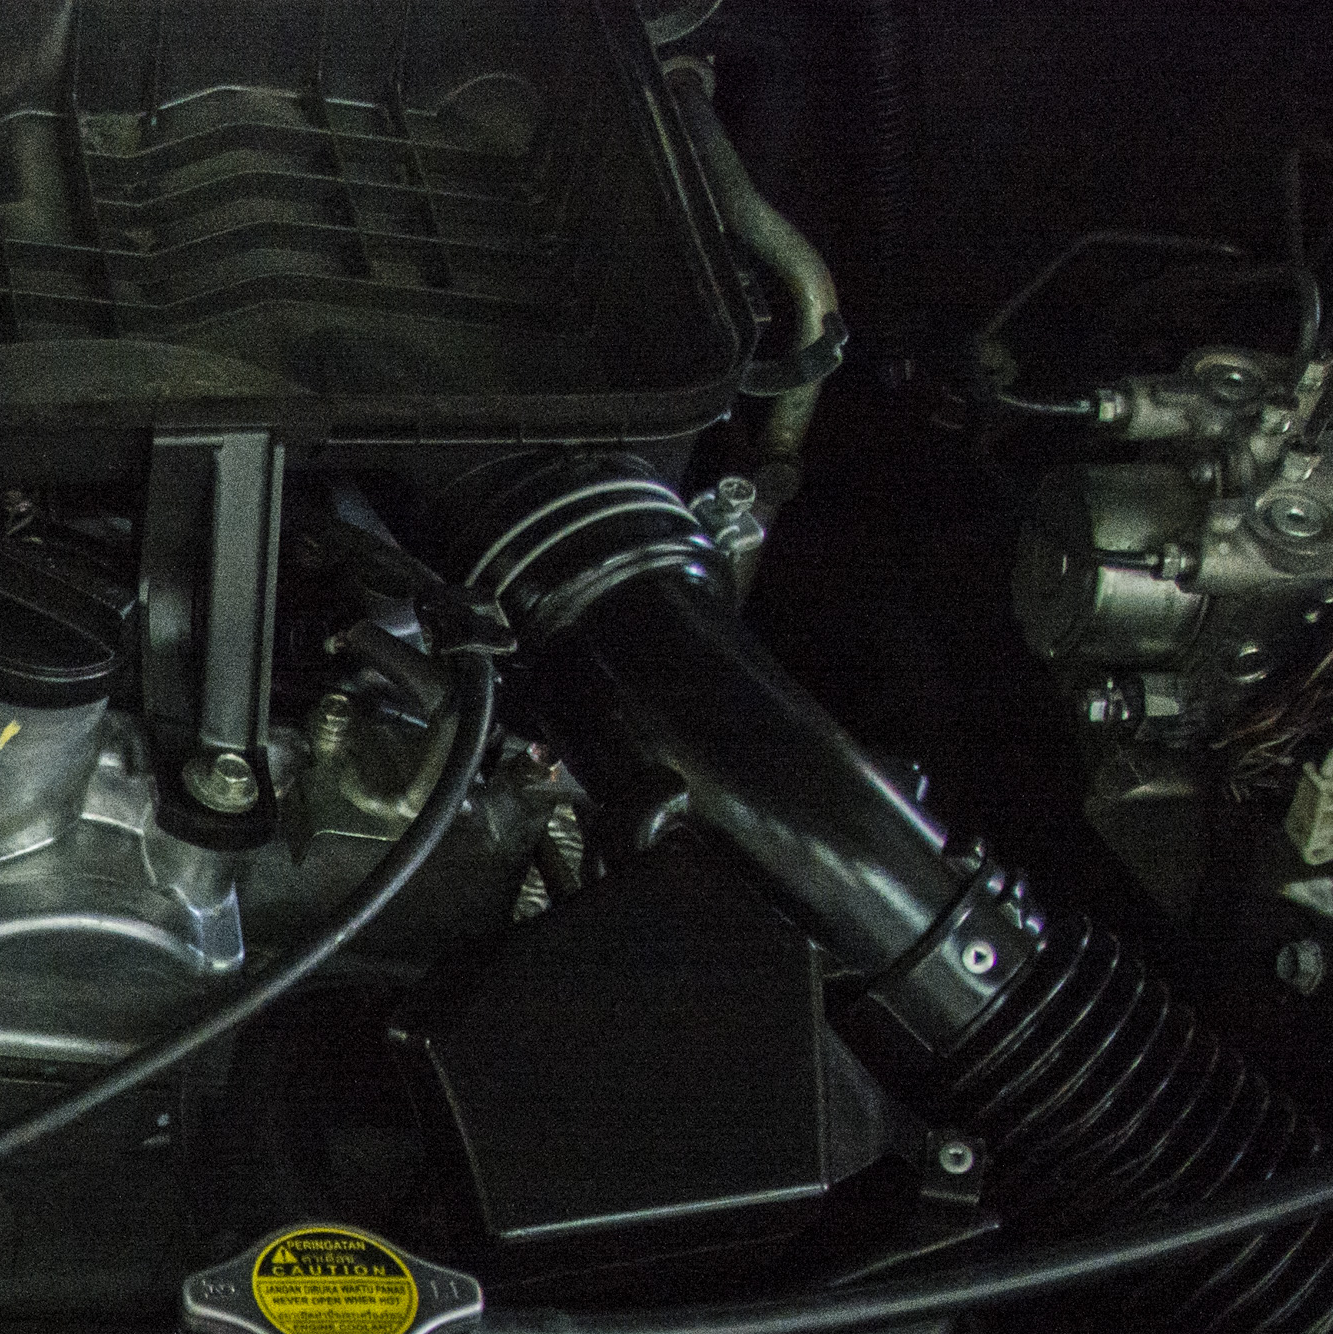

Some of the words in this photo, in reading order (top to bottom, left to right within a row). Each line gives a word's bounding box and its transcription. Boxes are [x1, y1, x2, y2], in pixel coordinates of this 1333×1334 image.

[286, 1240, 366, 1251] PERINGATAN
[272, 1265, 386, 1277] CAUTION
[273, 1296, 309, 1305] NEVER
[311, 1296, 341, 1305] OPEN
[344, 1296, 376, 1305] WHEN
